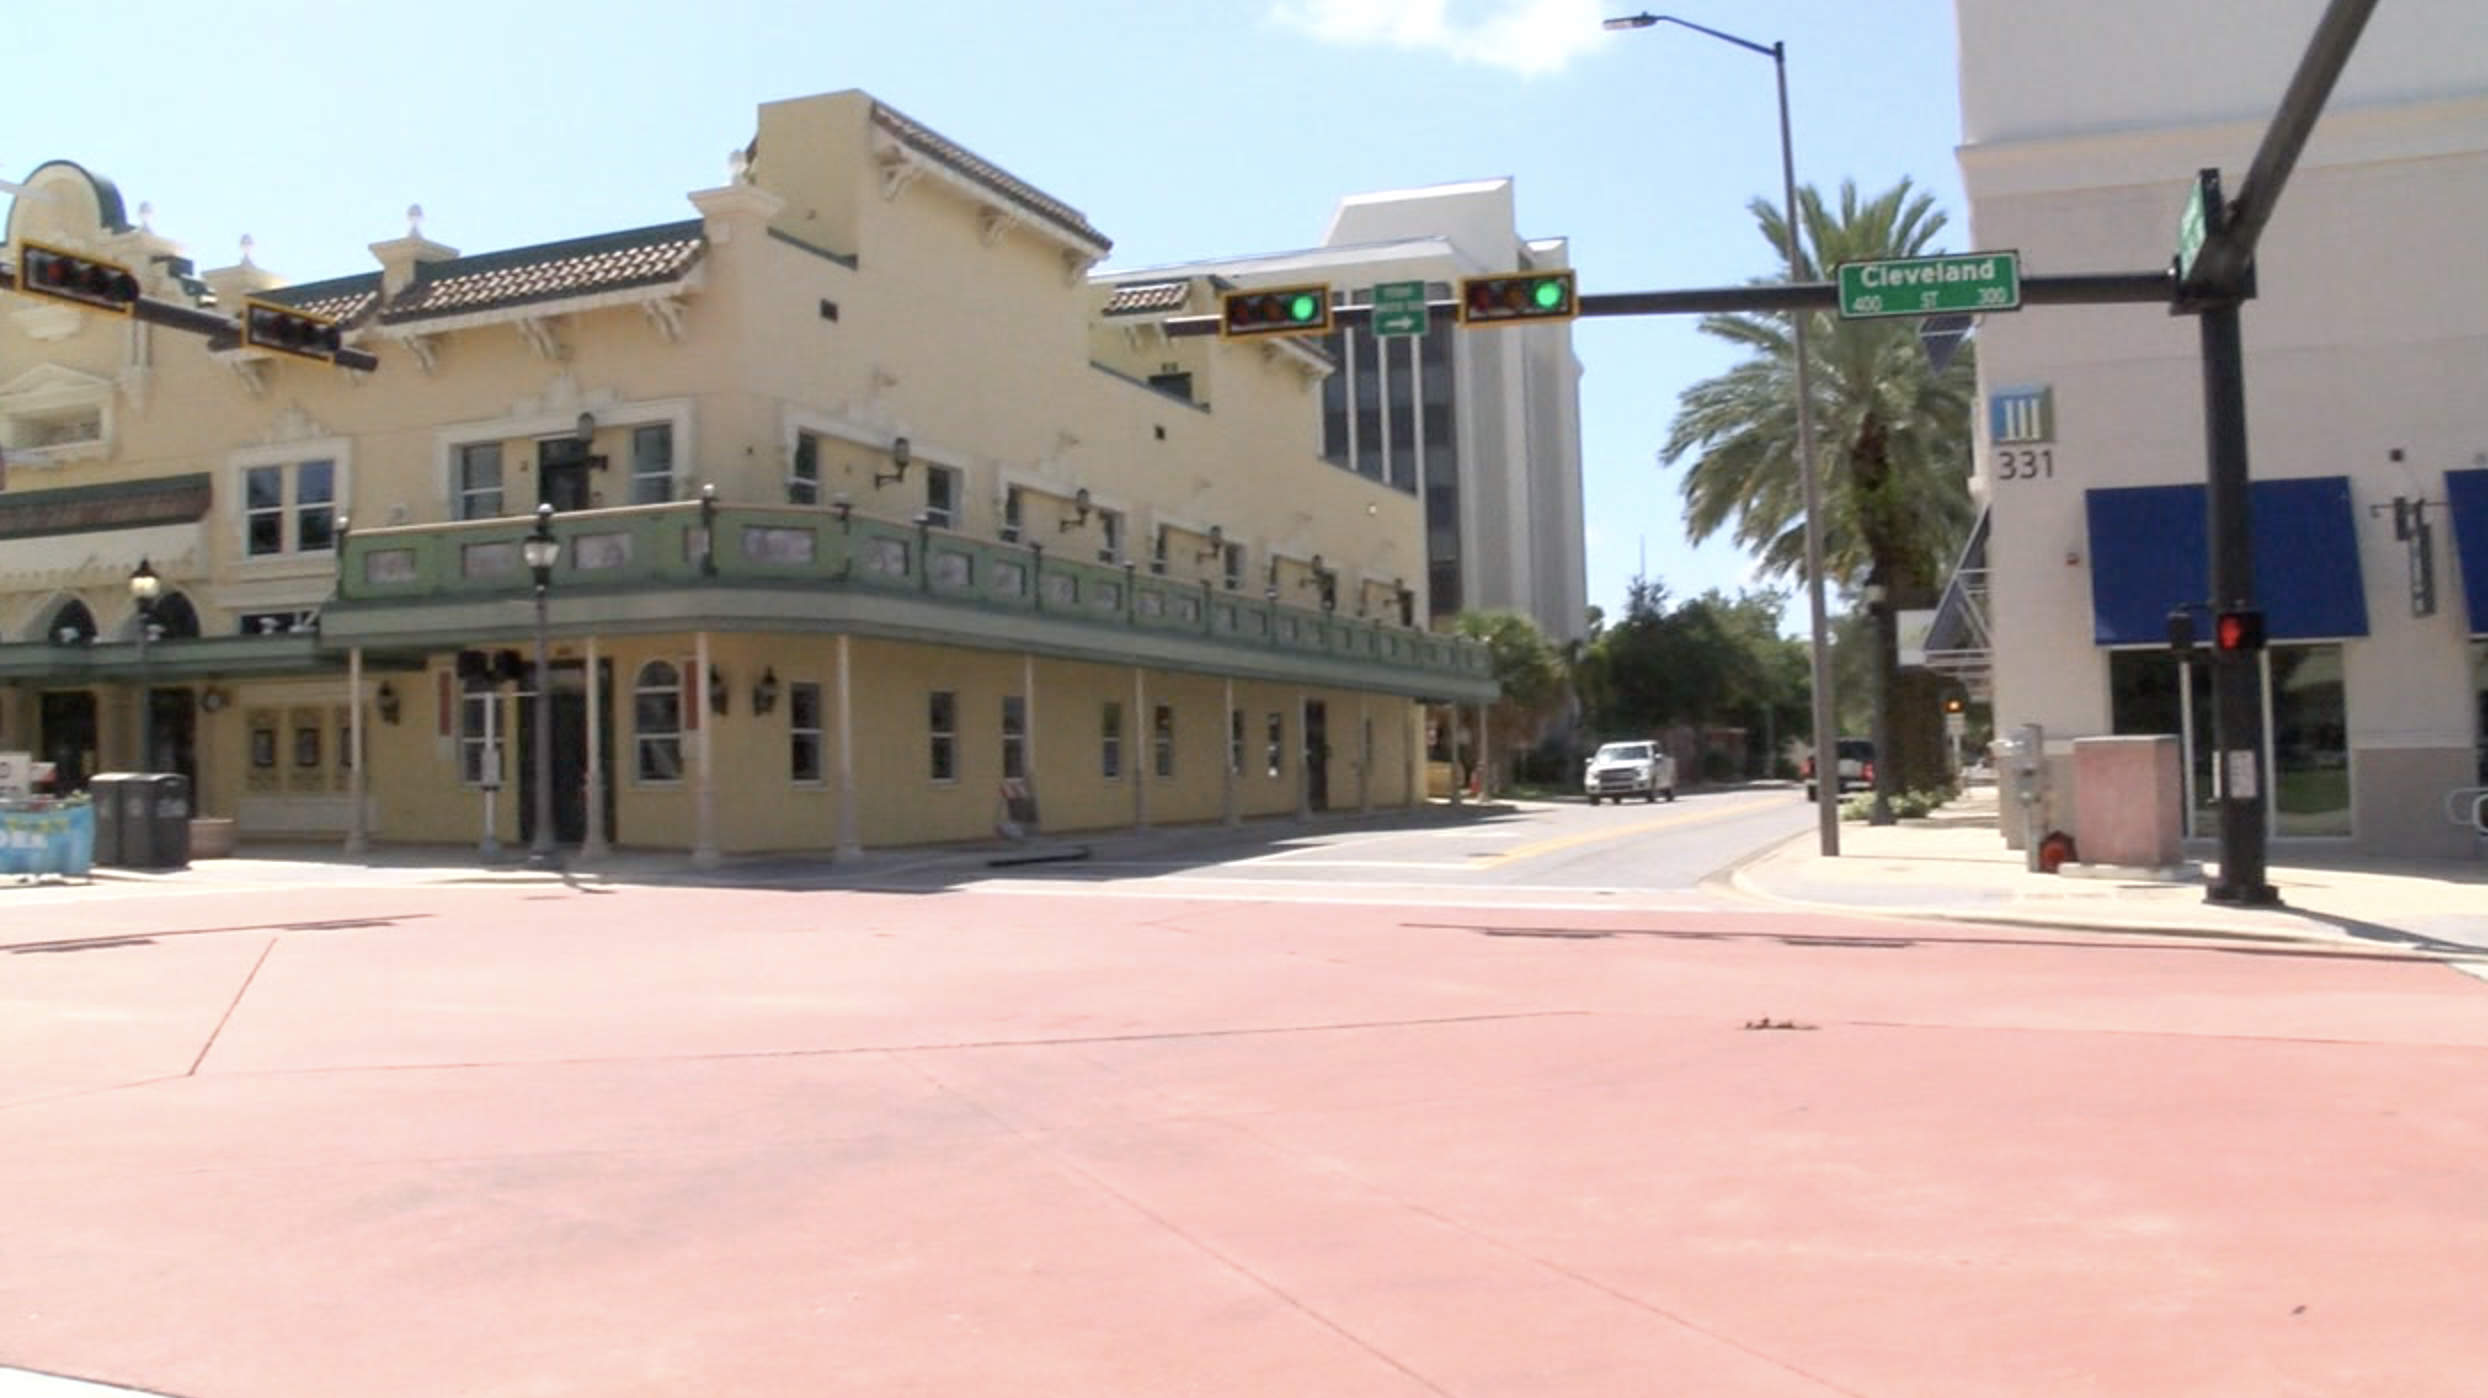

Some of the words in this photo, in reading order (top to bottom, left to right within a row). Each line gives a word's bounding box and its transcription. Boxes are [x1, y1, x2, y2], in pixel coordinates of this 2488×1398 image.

[1861, 260, 1995, 287] Cleveland
[1853, 295, 1882, 312] 400
[1920, 291, 1938, 308] ST
[1978, 287, 2006, 305] 300
[1999, 449, 2053, 480] 331
